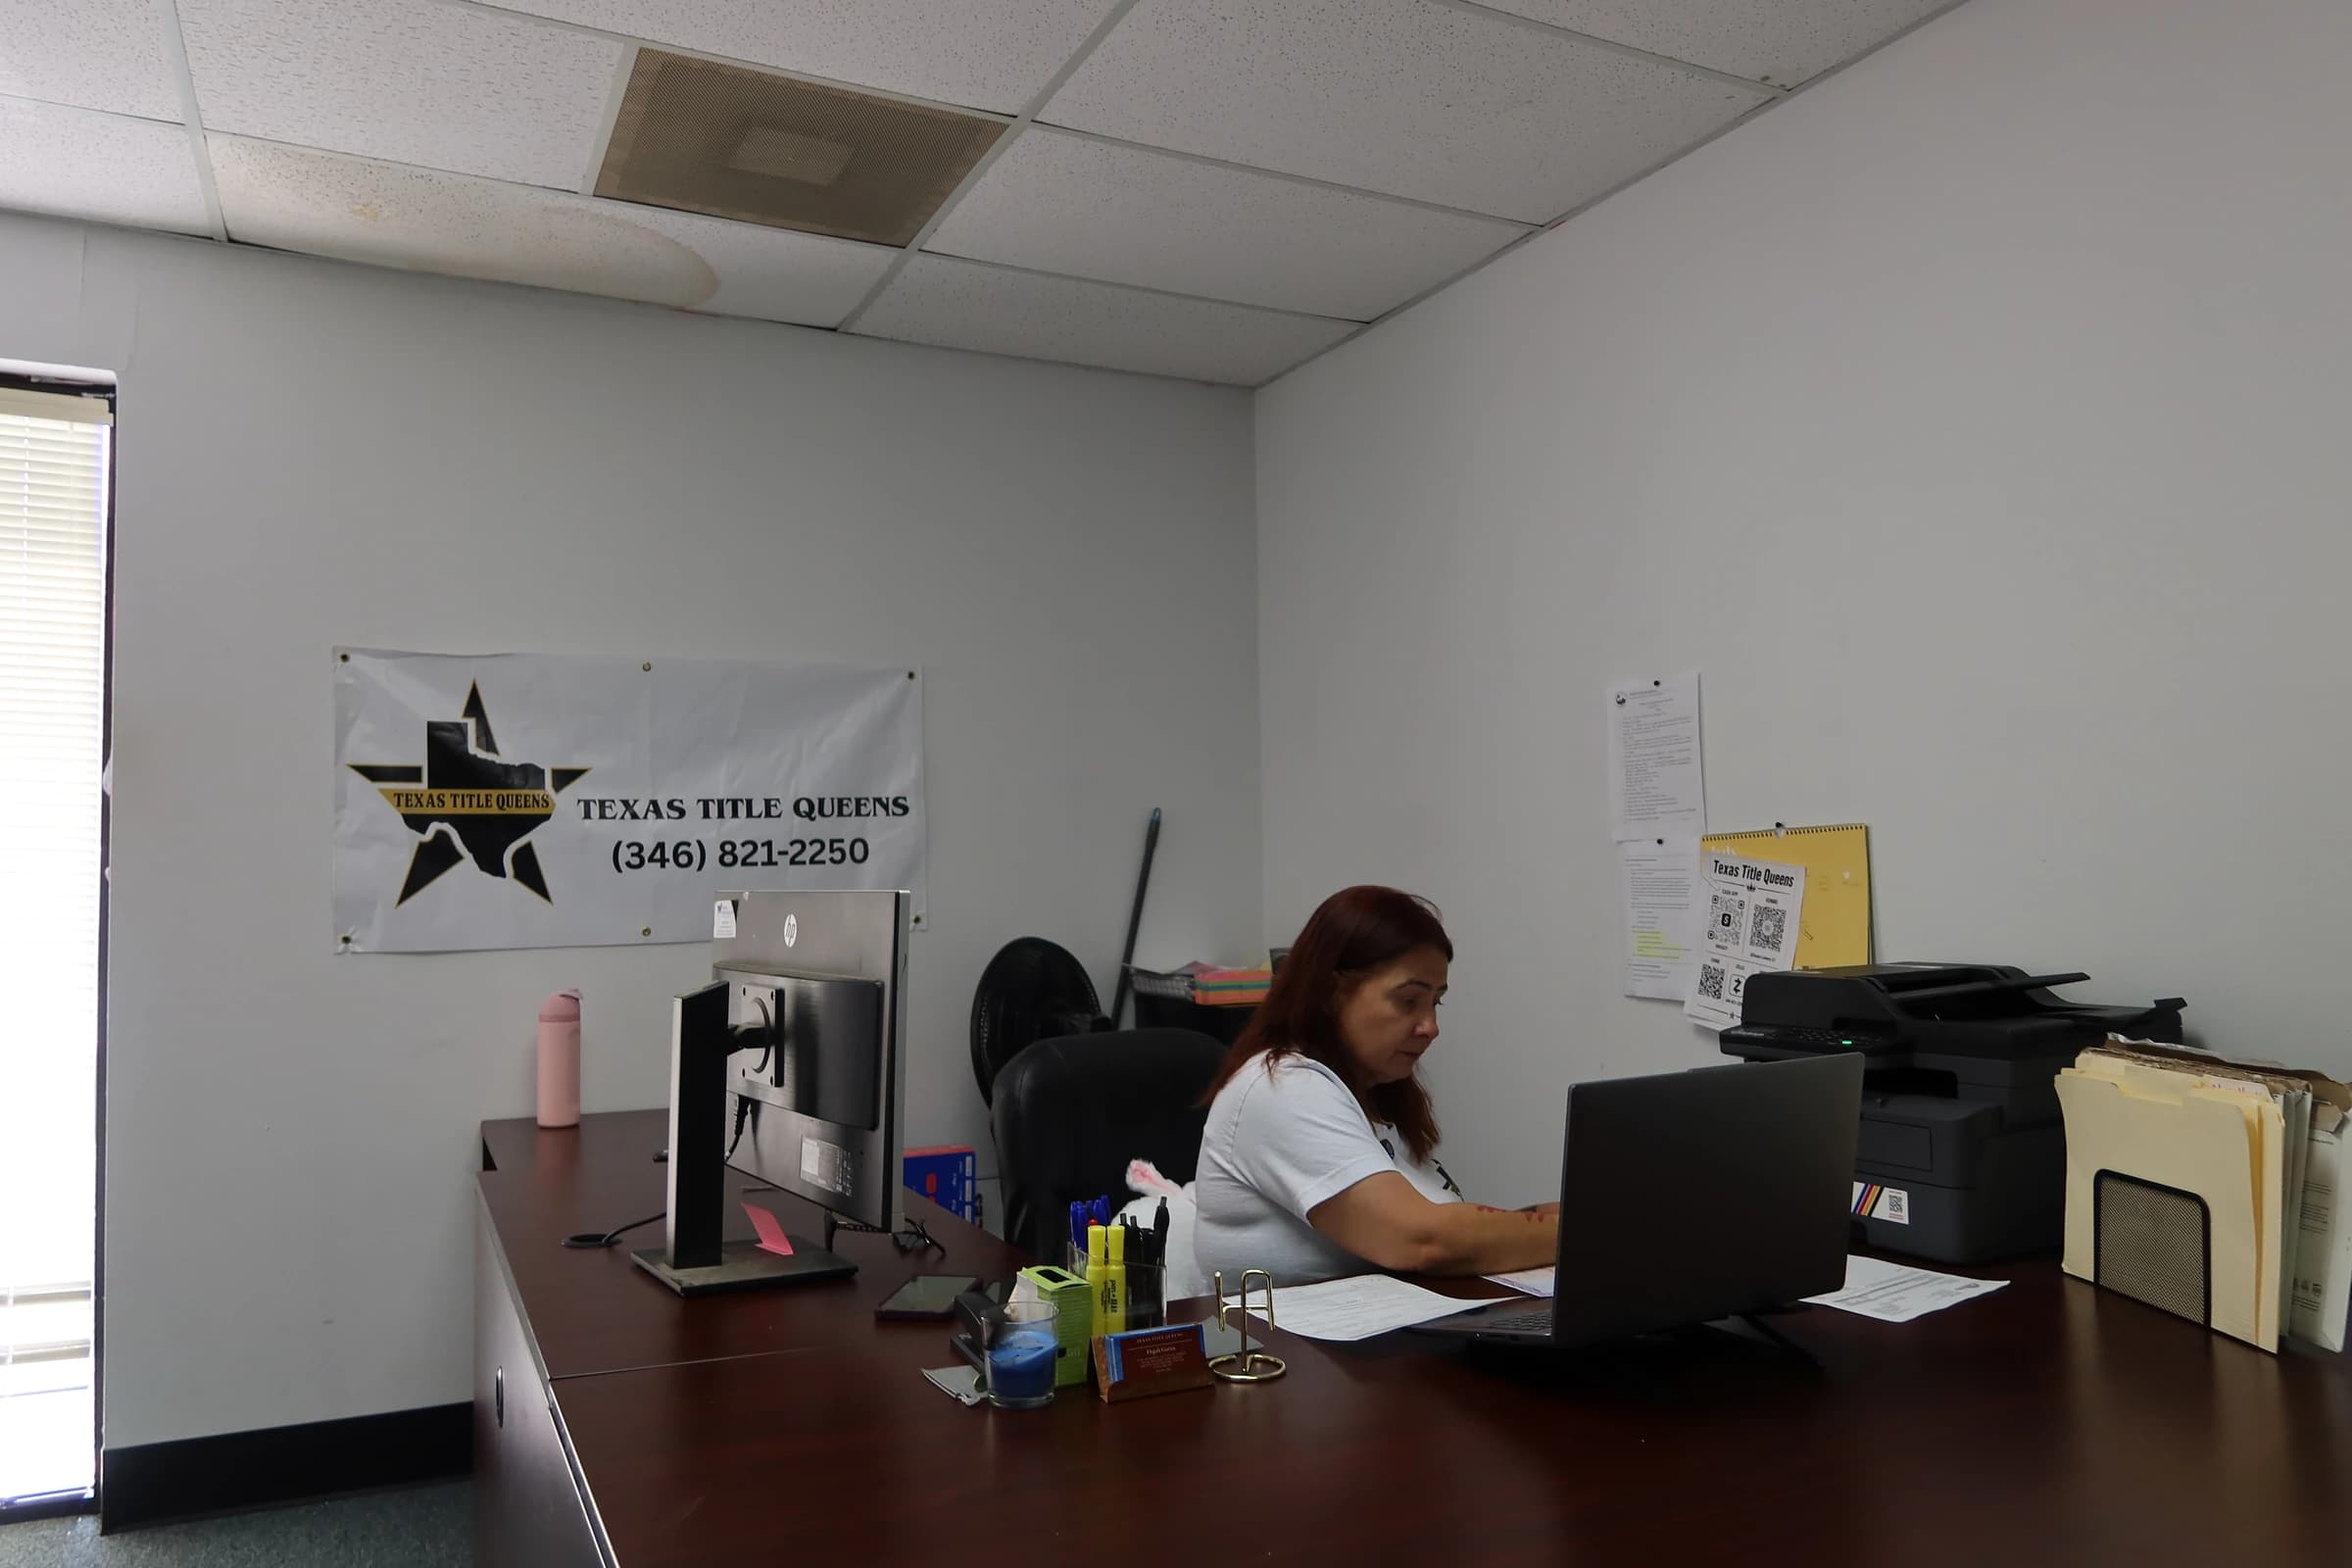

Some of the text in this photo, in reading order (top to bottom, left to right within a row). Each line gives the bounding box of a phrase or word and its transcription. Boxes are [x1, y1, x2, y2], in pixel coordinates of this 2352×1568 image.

[394, 793, 549, 810] TEXAS TITLE QUEENS
[576, 796, 909, 821] TEXAS TITLE QUEENS
[612, 837, 869, 873] (346) 821-2250
[1714, 859, 1794, 887] Texas Title Queens
